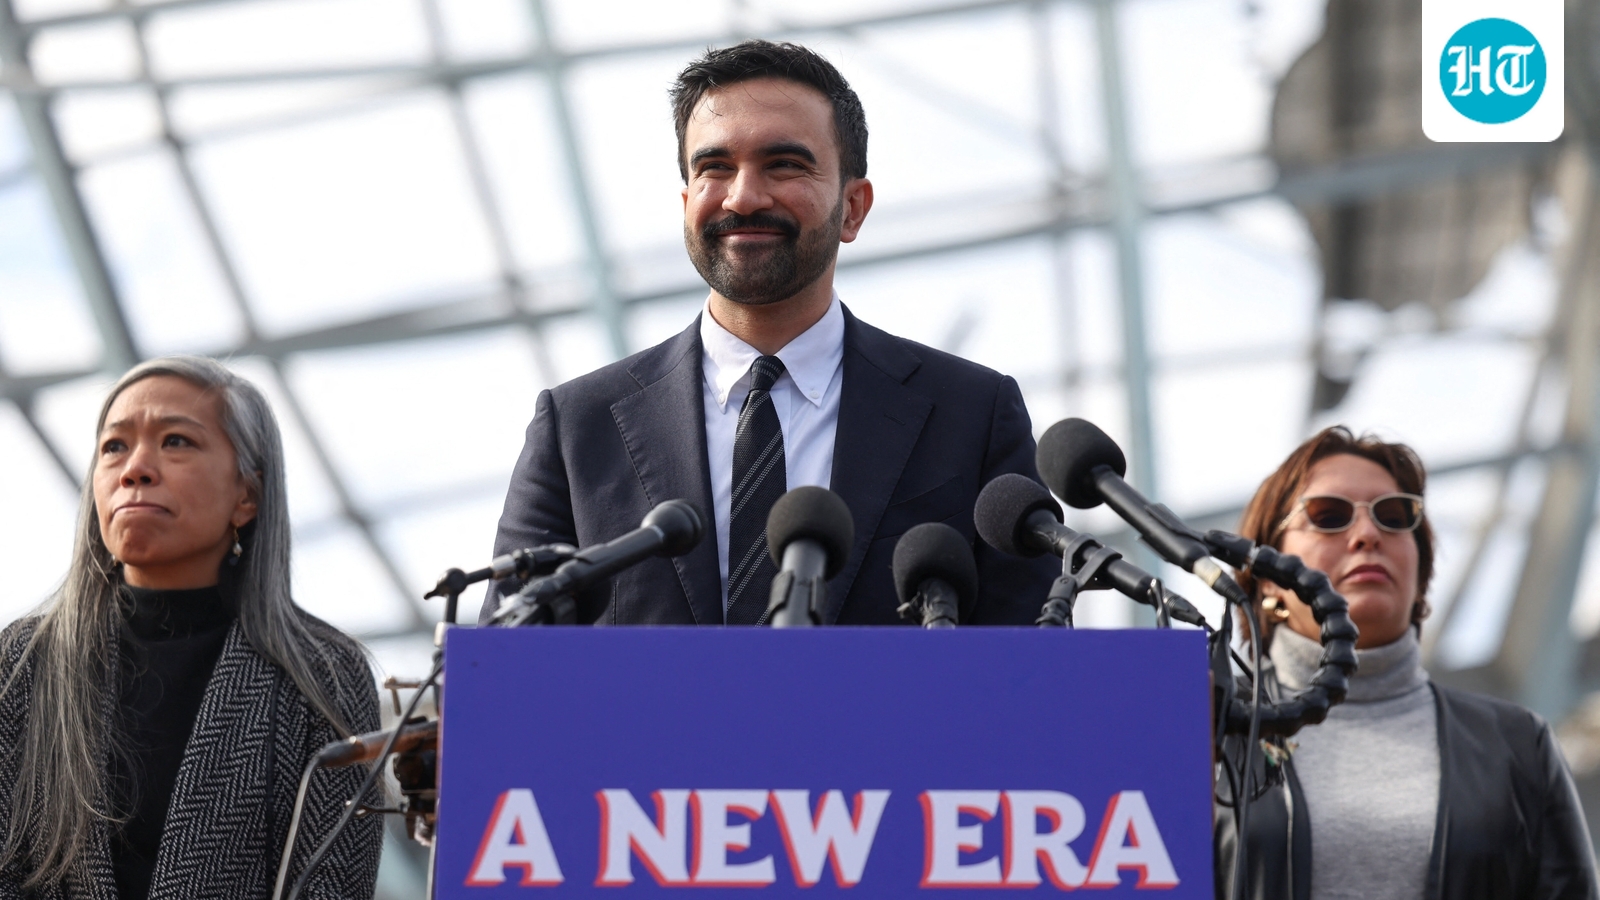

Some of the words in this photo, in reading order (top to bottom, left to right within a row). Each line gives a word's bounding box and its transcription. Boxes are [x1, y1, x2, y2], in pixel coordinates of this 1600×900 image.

[465, 788, 564, 887] A
[595, 788, 891, 889] NEW
[919, 789, 1180, 890] ERA
